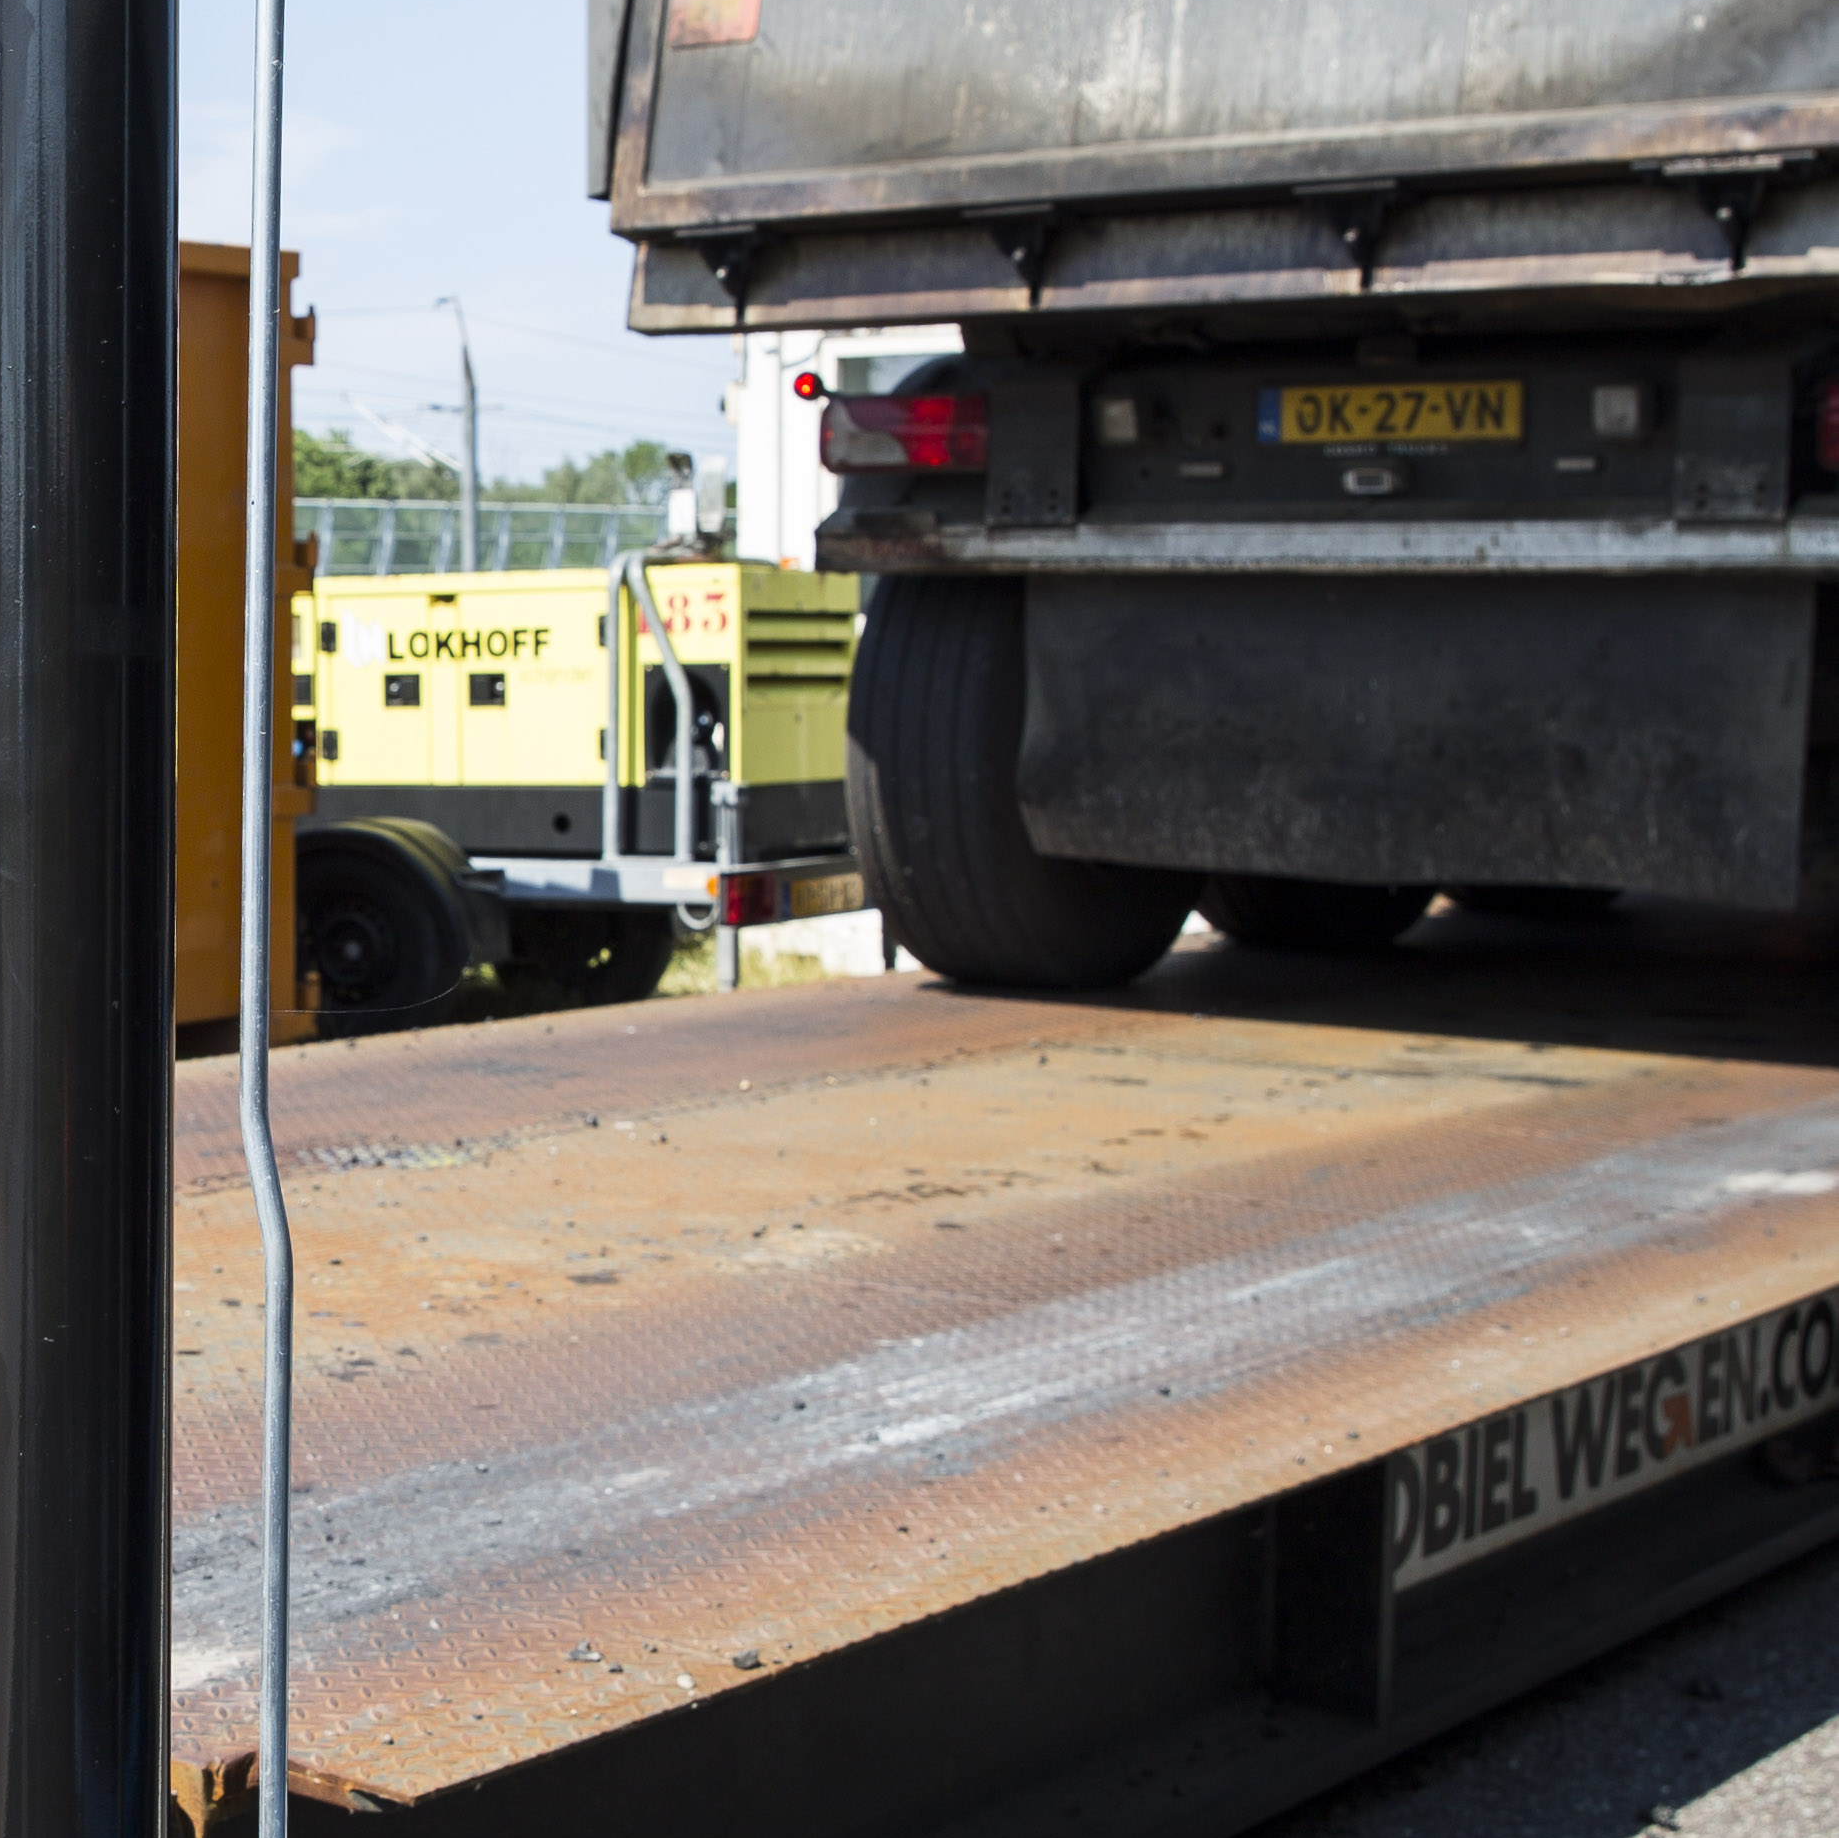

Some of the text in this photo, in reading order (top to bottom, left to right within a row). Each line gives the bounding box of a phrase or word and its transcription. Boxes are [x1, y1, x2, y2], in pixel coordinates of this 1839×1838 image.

[1295, 387, 1505, 435] OK-27-VN
[388, 628, 550, 660] LOKHOFF
[1551, 1299, 1839, 1500] WEGEN.CO
